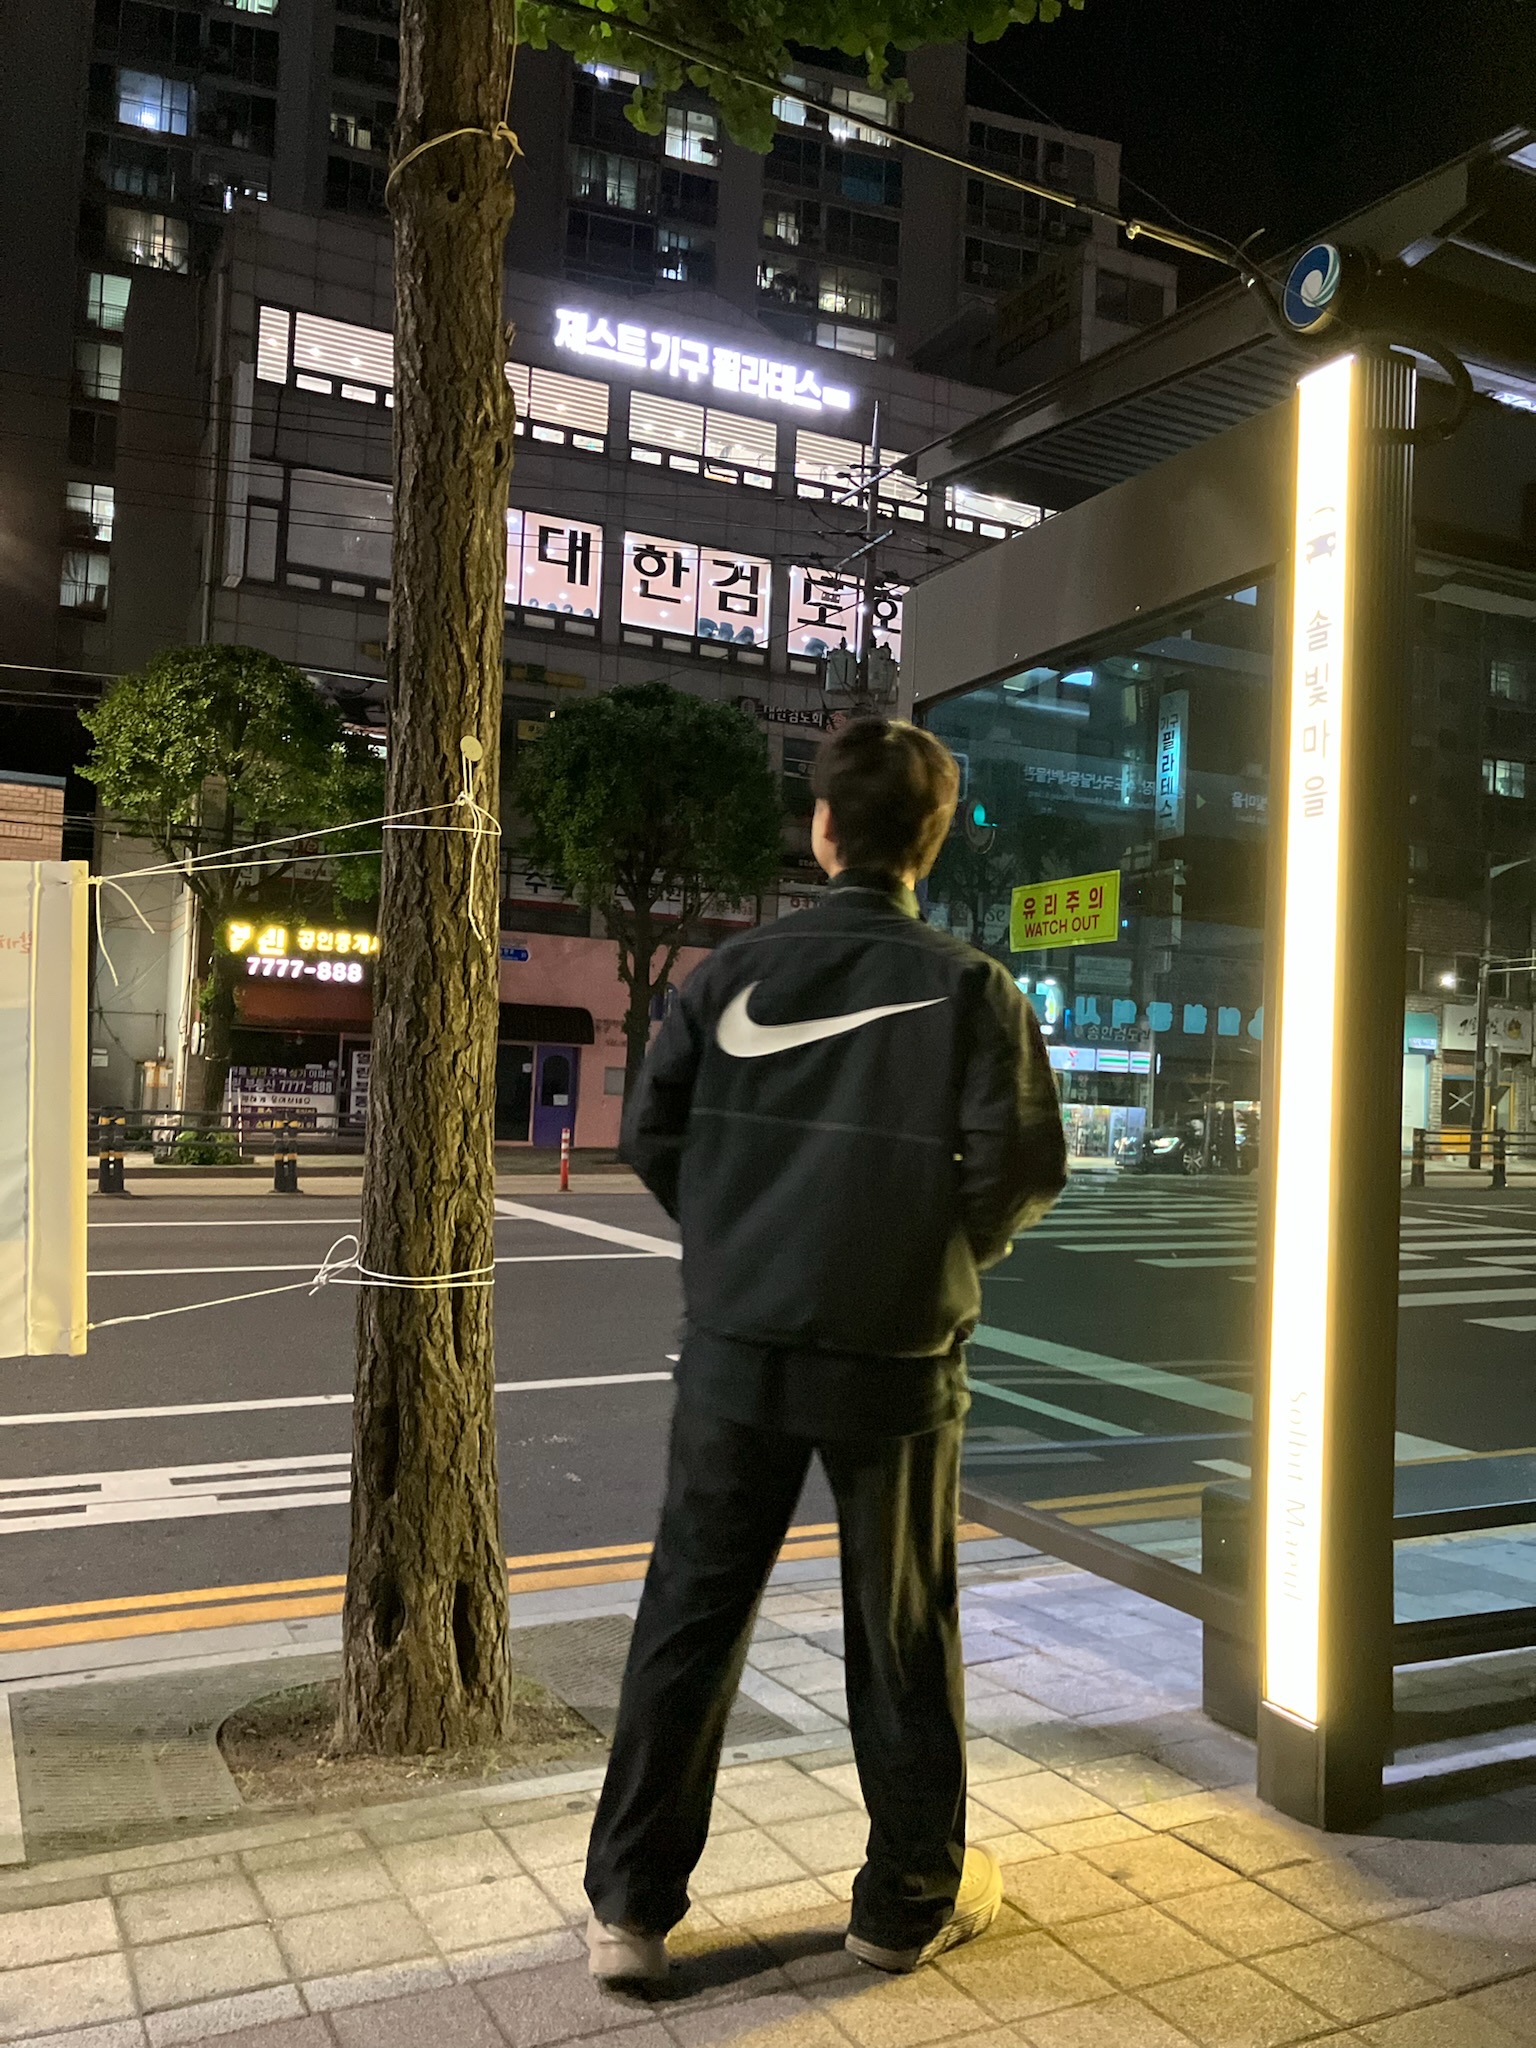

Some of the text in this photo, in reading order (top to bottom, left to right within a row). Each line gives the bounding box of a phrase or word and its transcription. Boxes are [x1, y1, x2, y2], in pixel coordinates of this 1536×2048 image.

[650, 331, 709, 384] 기구
[712, 346, 823, 411] 필라테스
[1301, 609, 1333, 819] 솔빛마을
[1159, 730, 1176, 819] 필라테스
[1023, 886, 1104, 920] 유리주의
[1024, 919, 1068, 939] WATCH
[1071, 914, 1101, 932] OUT
[247, 957, 363, 984] 7777-888
[244, 1078, 276, 1093] 부동산
